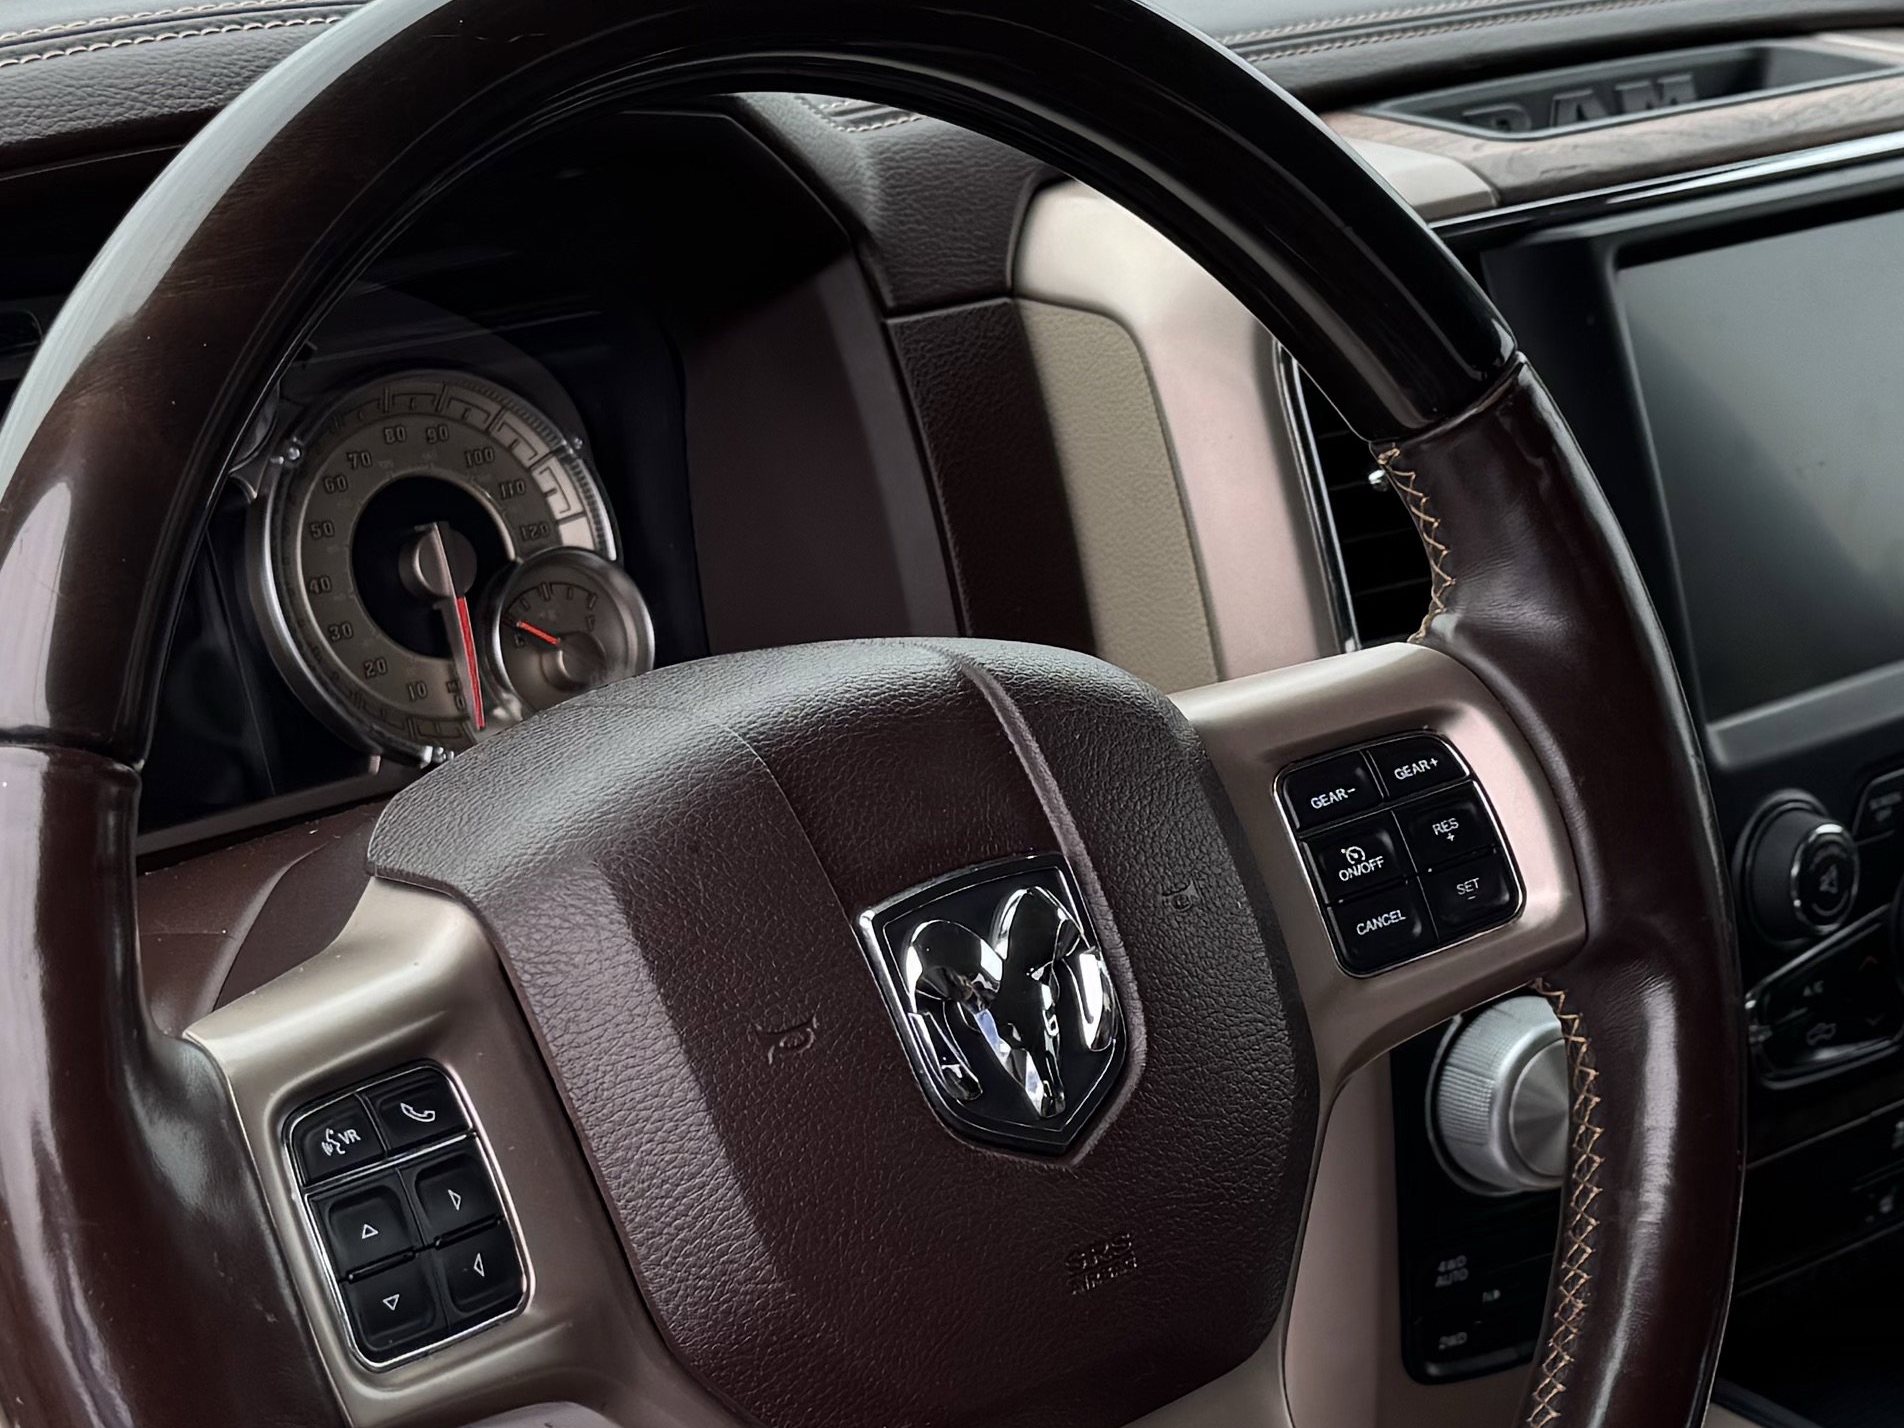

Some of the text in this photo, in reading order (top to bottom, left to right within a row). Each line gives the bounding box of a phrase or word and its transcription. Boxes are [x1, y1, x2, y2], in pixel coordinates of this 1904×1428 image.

[1462, 72, 1698, 133] RAM
[383, 426, 407, 444] 80
[426, 425, 449, 444] 90
[347, 450, 372, 469] 70
[464, 447, 495, 469] 100
[323, 475, 347, 494] 60
[499, 479, 526, 500] 110
[309, 522, 335, 540] 50
[308, 576, 331, 595] 40
[329, 622, 353, 642] 30
[364, 658, 388, 678] 20
[407, 682, 428, 702] 10
[1432, 817, 1459, 836] RES
[1338, 855, 1385, 882] ON/OFF
[1456, 878, 1480, 896] SET
[1356, 909, 1406, 936] CANCEL
[338, 1128, 361, 1145] VR
